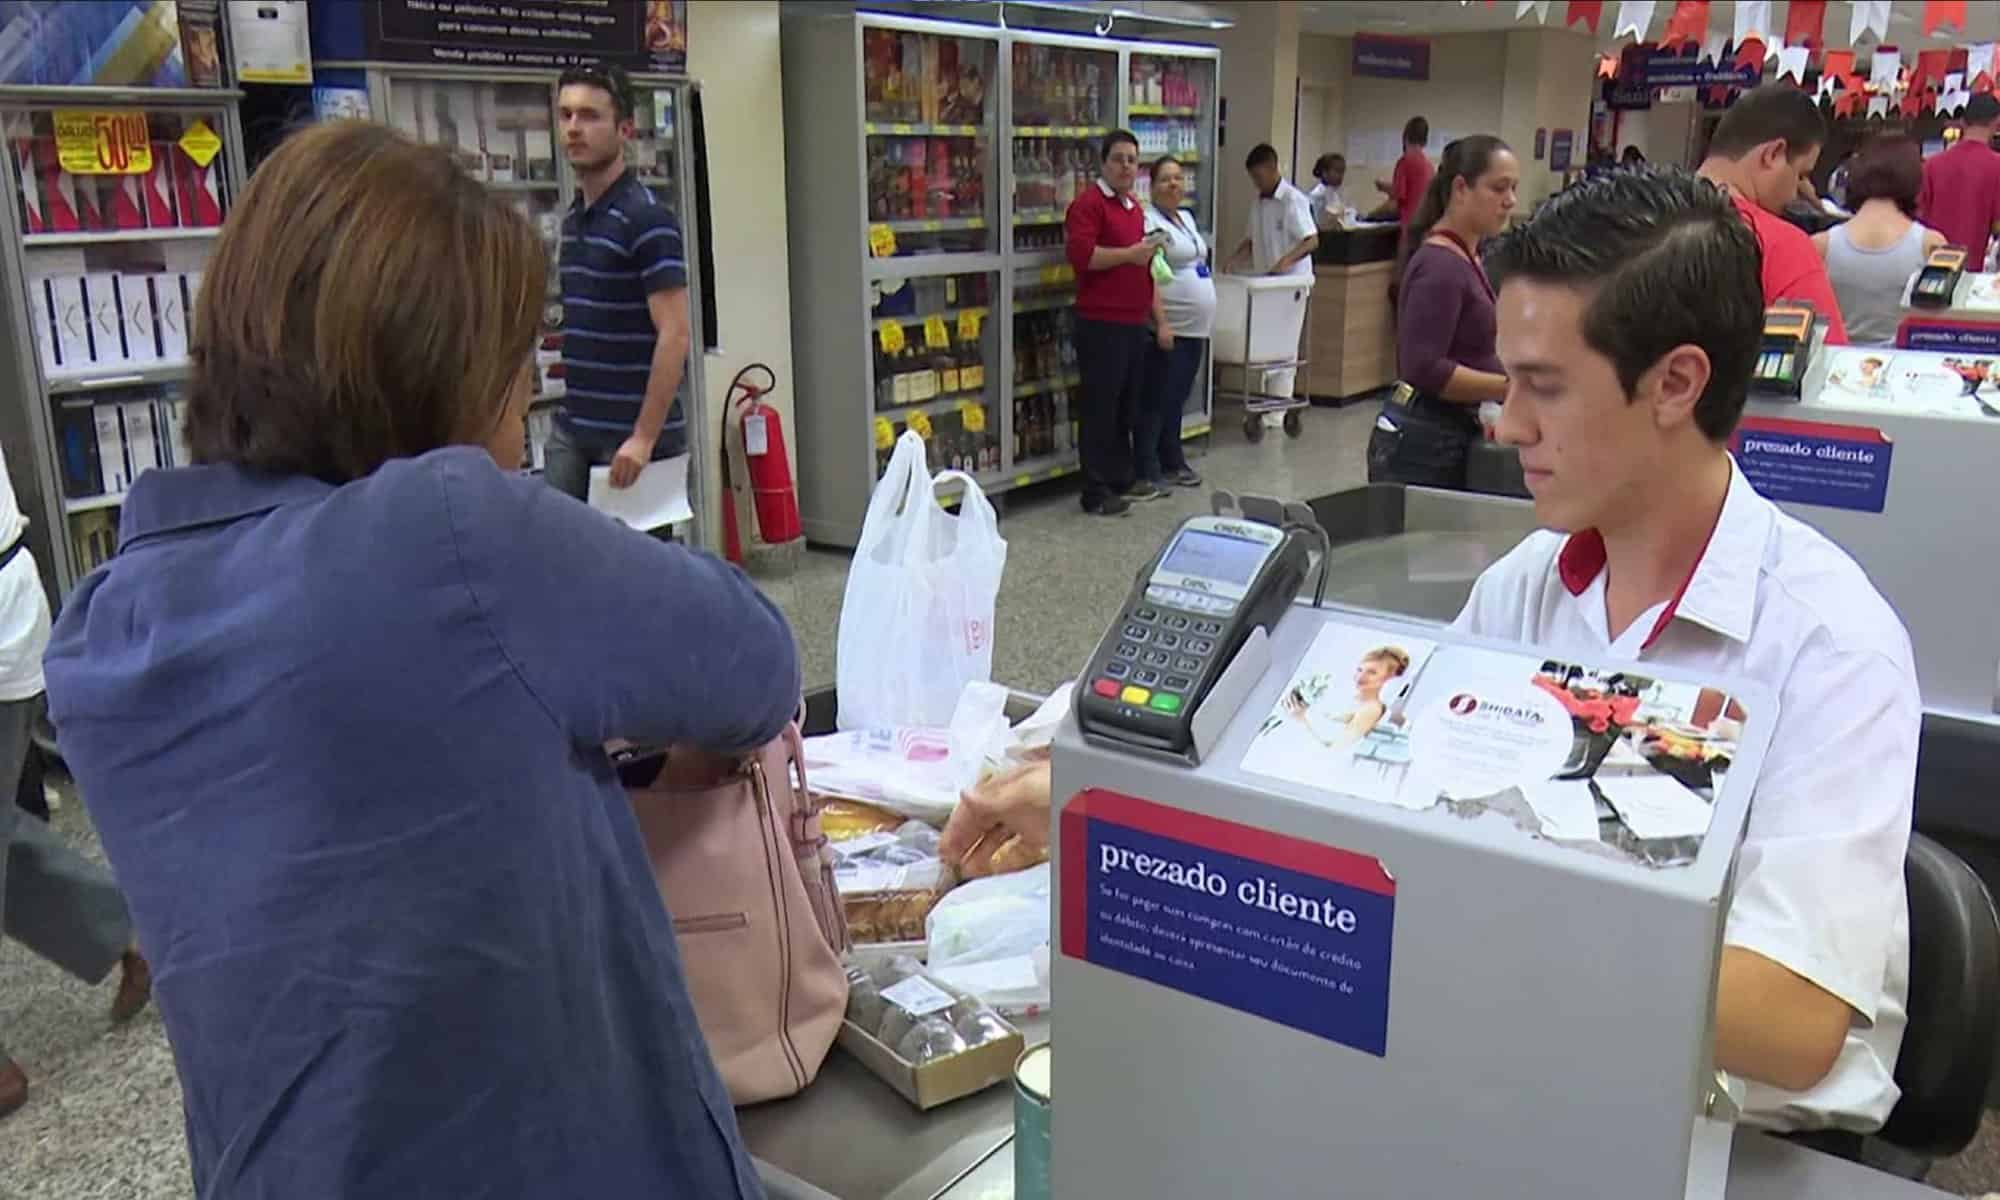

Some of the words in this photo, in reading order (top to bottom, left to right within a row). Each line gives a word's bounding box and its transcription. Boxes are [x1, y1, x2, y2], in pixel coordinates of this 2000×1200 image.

[1744, 439, 1812, 456] prezado
[1815, 444, 1875, 464] cliente
[1100, 843, 1228, 897] prezado
[1237, 877, 1357, 934] cliente
